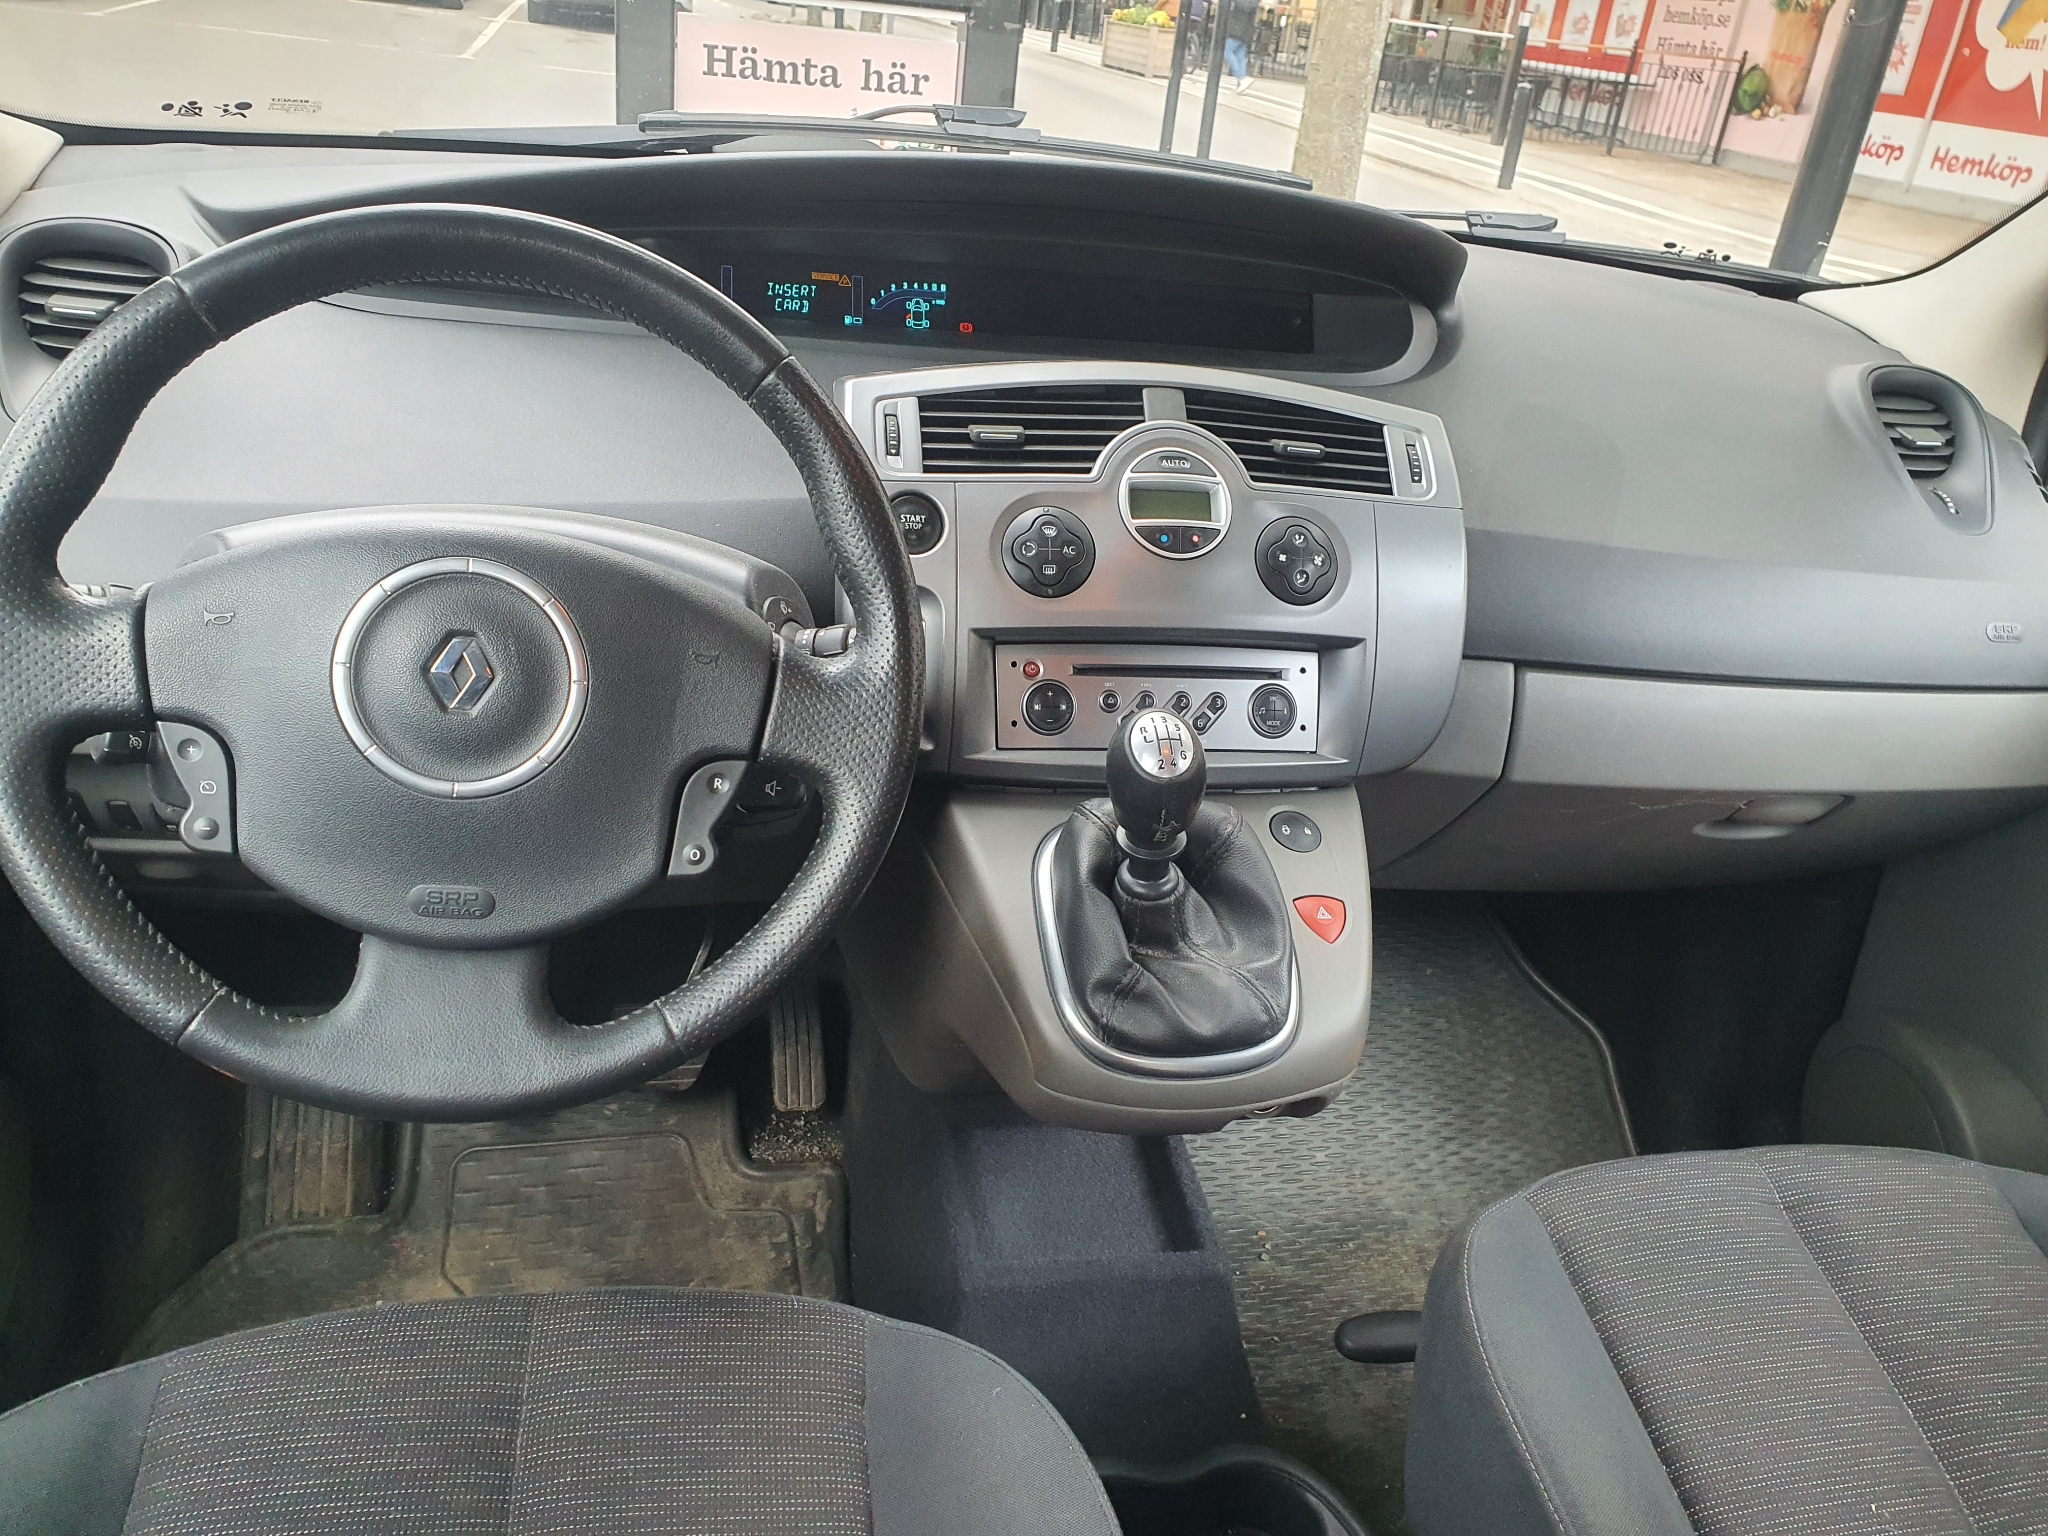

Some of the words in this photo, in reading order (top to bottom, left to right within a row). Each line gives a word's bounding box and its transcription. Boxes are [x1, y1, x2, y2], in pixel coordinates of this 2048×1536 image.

[702, 42, 843, 89] Hämta
[860, 58, 931, 96] här
[1860, 133, 1905, 167] köp
[1930, 145, 2034, 189] Hemköp
[812, 272, 839, 281] SERVICE
[767, 282, 817, 297] INSERT
[774, 298, 810, 313] CARD
[1161, 459, 1188, 467] AUTO
[900, 514, 926, 523] START
[905, 522, 922, 530] STOP
[1062, 545, 1076, 555] AC
[1180, 698, 1186, 707] 2
[1215, 698, 1221, 707] 3
[1140, 726, 1148, 735] R
[1161, 716, 1168, 724] 3
[1174, 723, 1181, 732] 5
[1197, 719, 1203, 728] 6
[1158, 759, 1166, 770] 2
[1170, 758, 1177, 769] 4
[1180, 750, 1187, 760] 6
[713, 777, 723, 790] R
[426, 889, 479, 906] SRP
[419, 905, 446, 916] AIR
[450, 906, 484, 917] BAG
